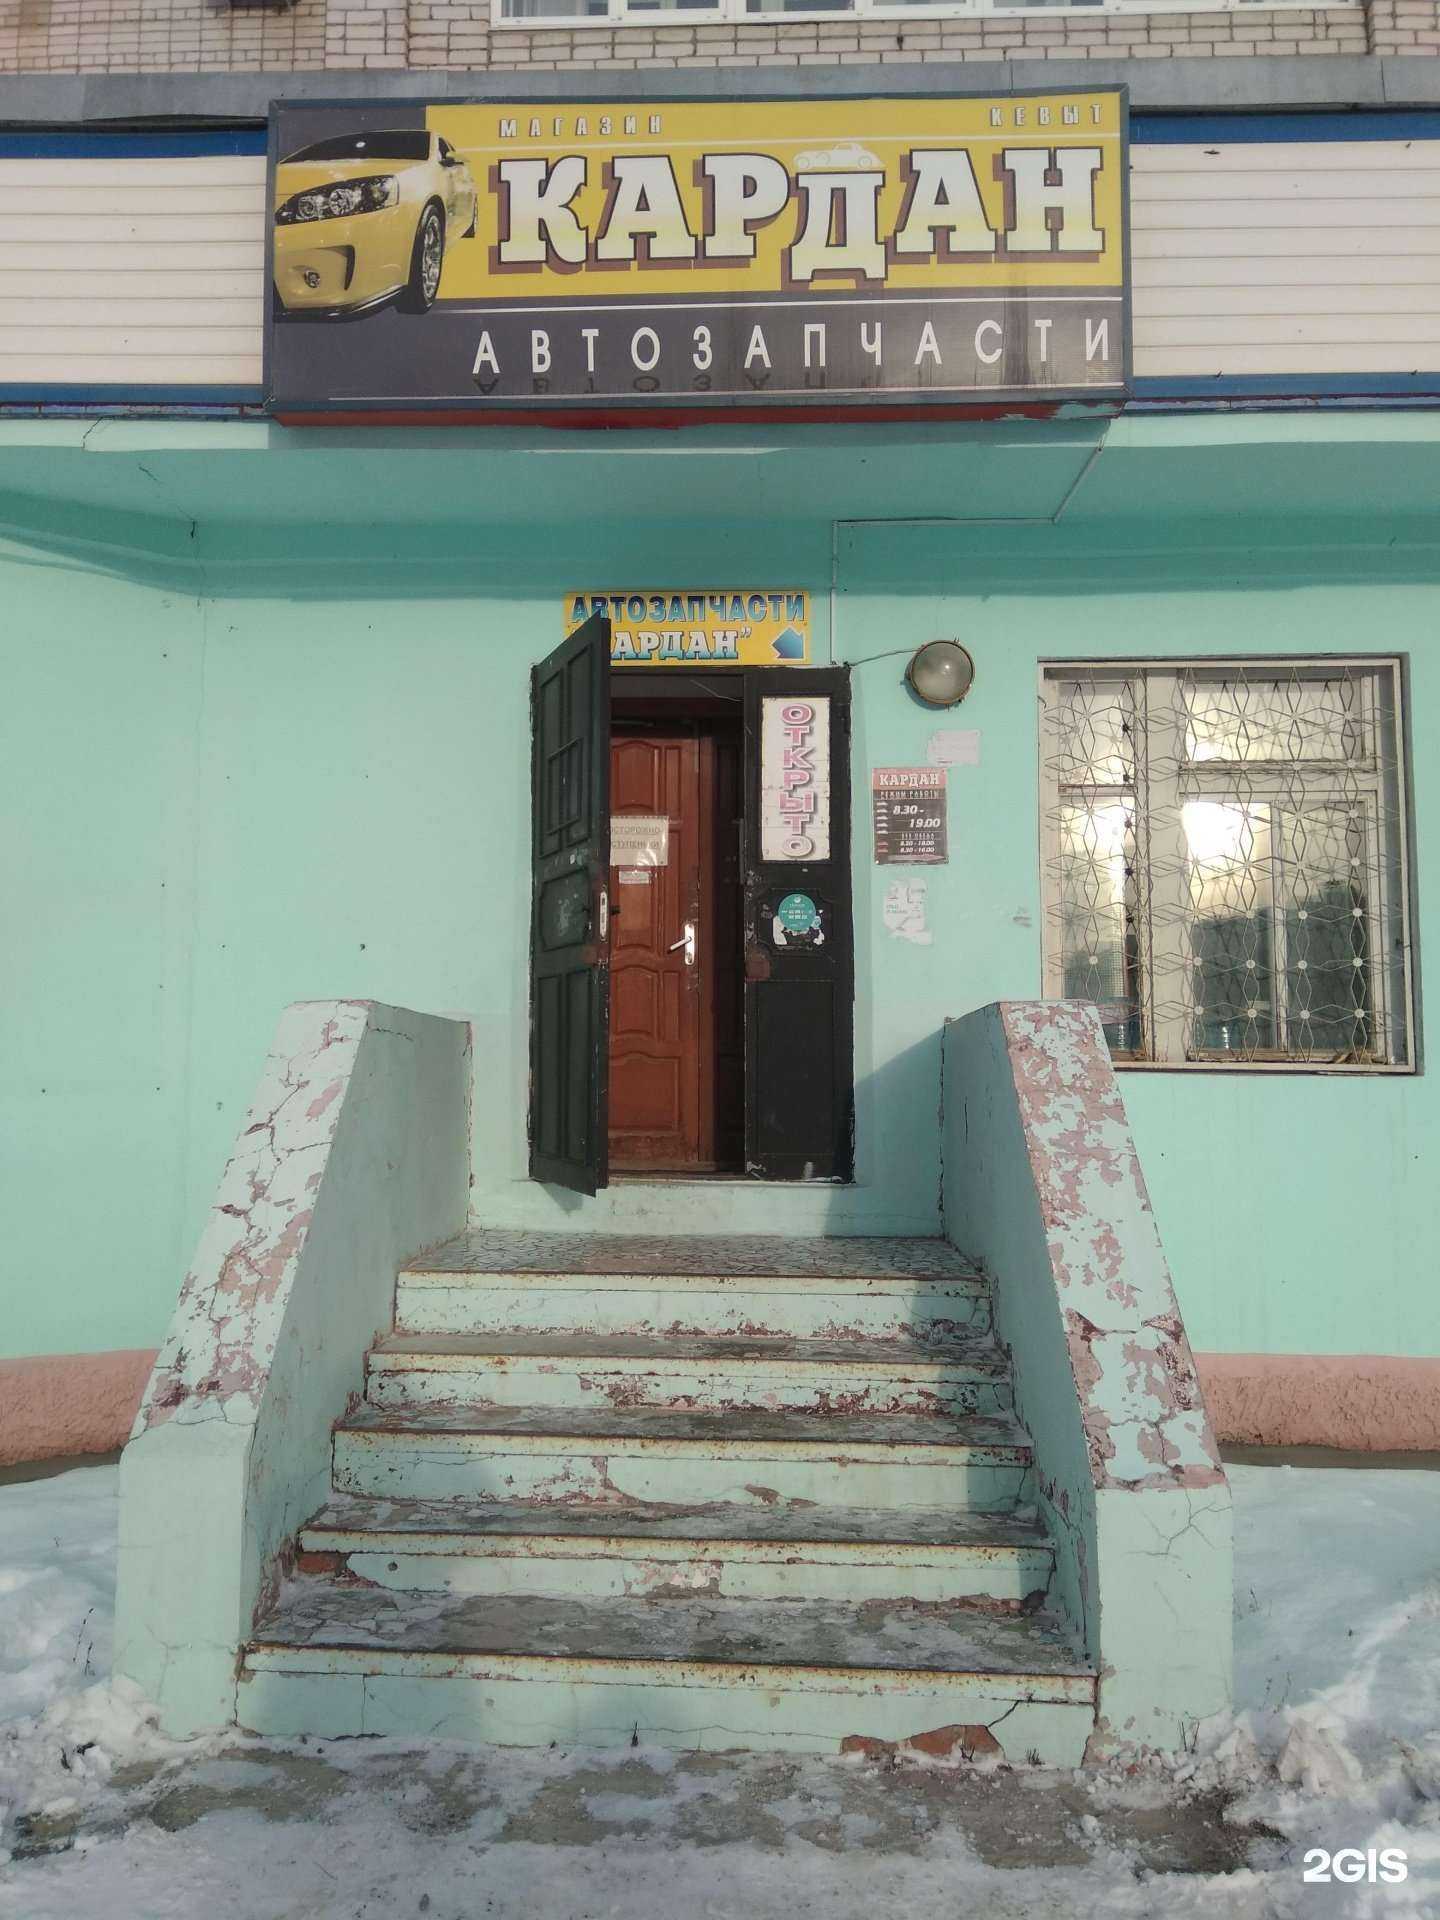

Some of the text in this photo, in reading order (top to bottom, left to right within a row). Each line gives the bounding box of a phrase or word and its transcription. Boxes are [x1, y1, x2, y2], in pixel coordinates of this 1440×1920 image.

[499, 114, 662, 138] МАГАЗИН
[990, 104, 1102, 127] КЕВЫТ
[495, 146, 1107, 285] КАРДАН
[472, 319, 1110, 374] АВТОЗАПЧАСТИ
[779, 703, 815, 858] ОТКРЫТО
[880, 773, 940, 788] КАРДАН
[893, 805, 918, 815] 8.30
[909, 818, 941, 828] 19.00
